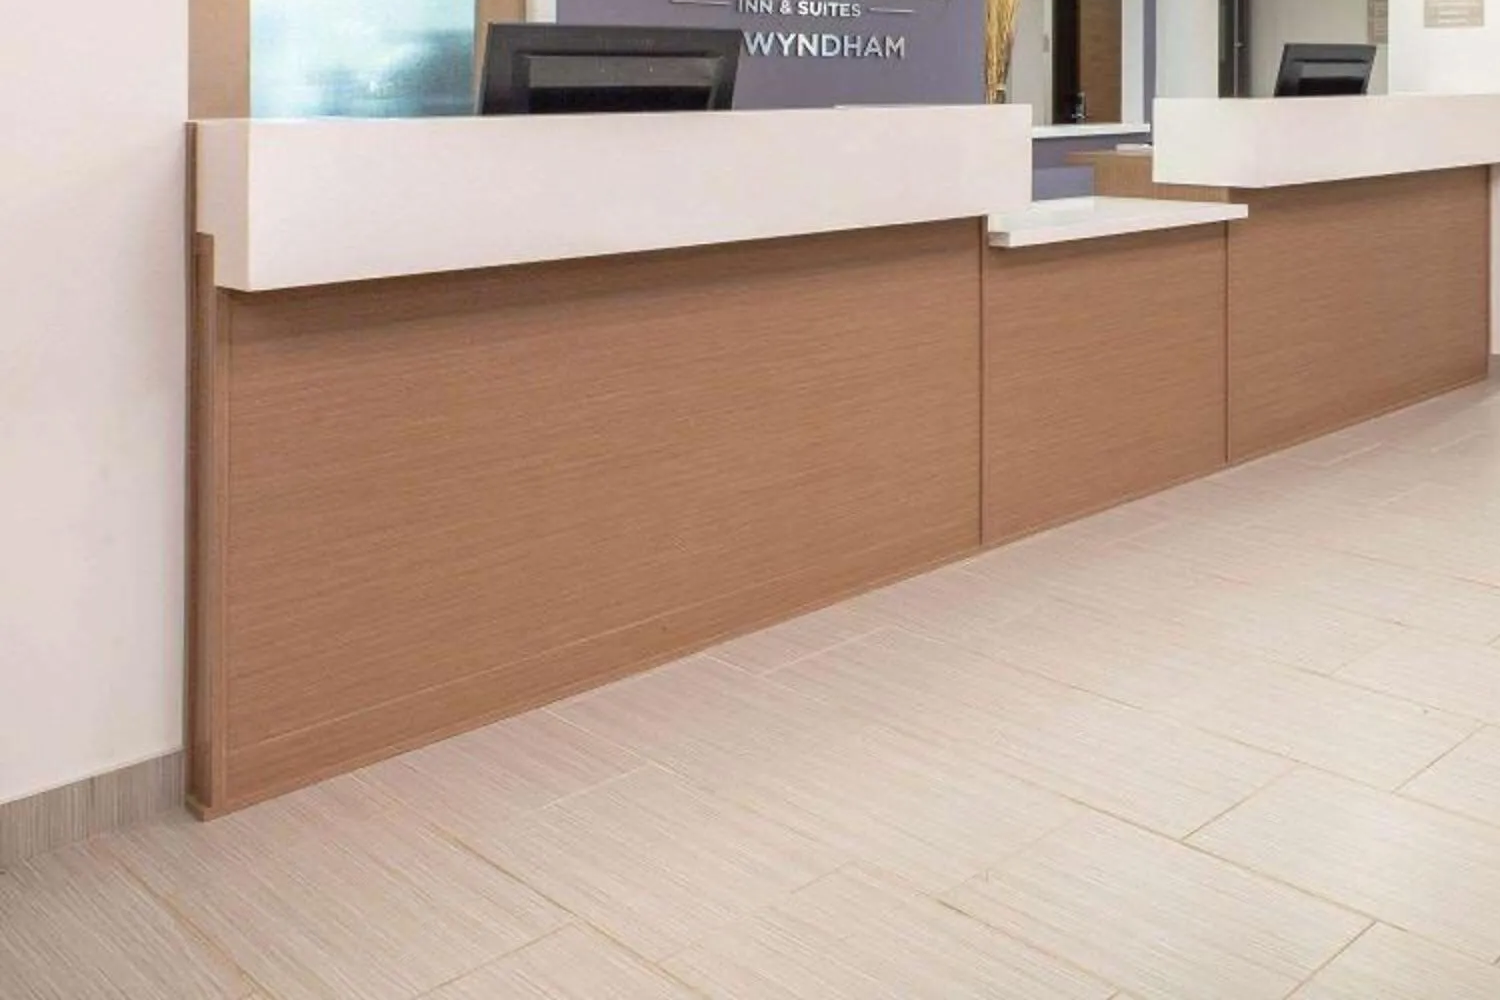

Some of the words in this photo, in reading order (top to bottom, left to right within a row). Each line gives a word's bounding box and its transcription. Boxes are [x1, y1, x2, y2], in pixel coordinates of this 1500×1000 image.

[779, 0, 794, 16] &
[797, 0, 861, 17] SUITES
[743, 31, 905, 59] WYNDHAM
